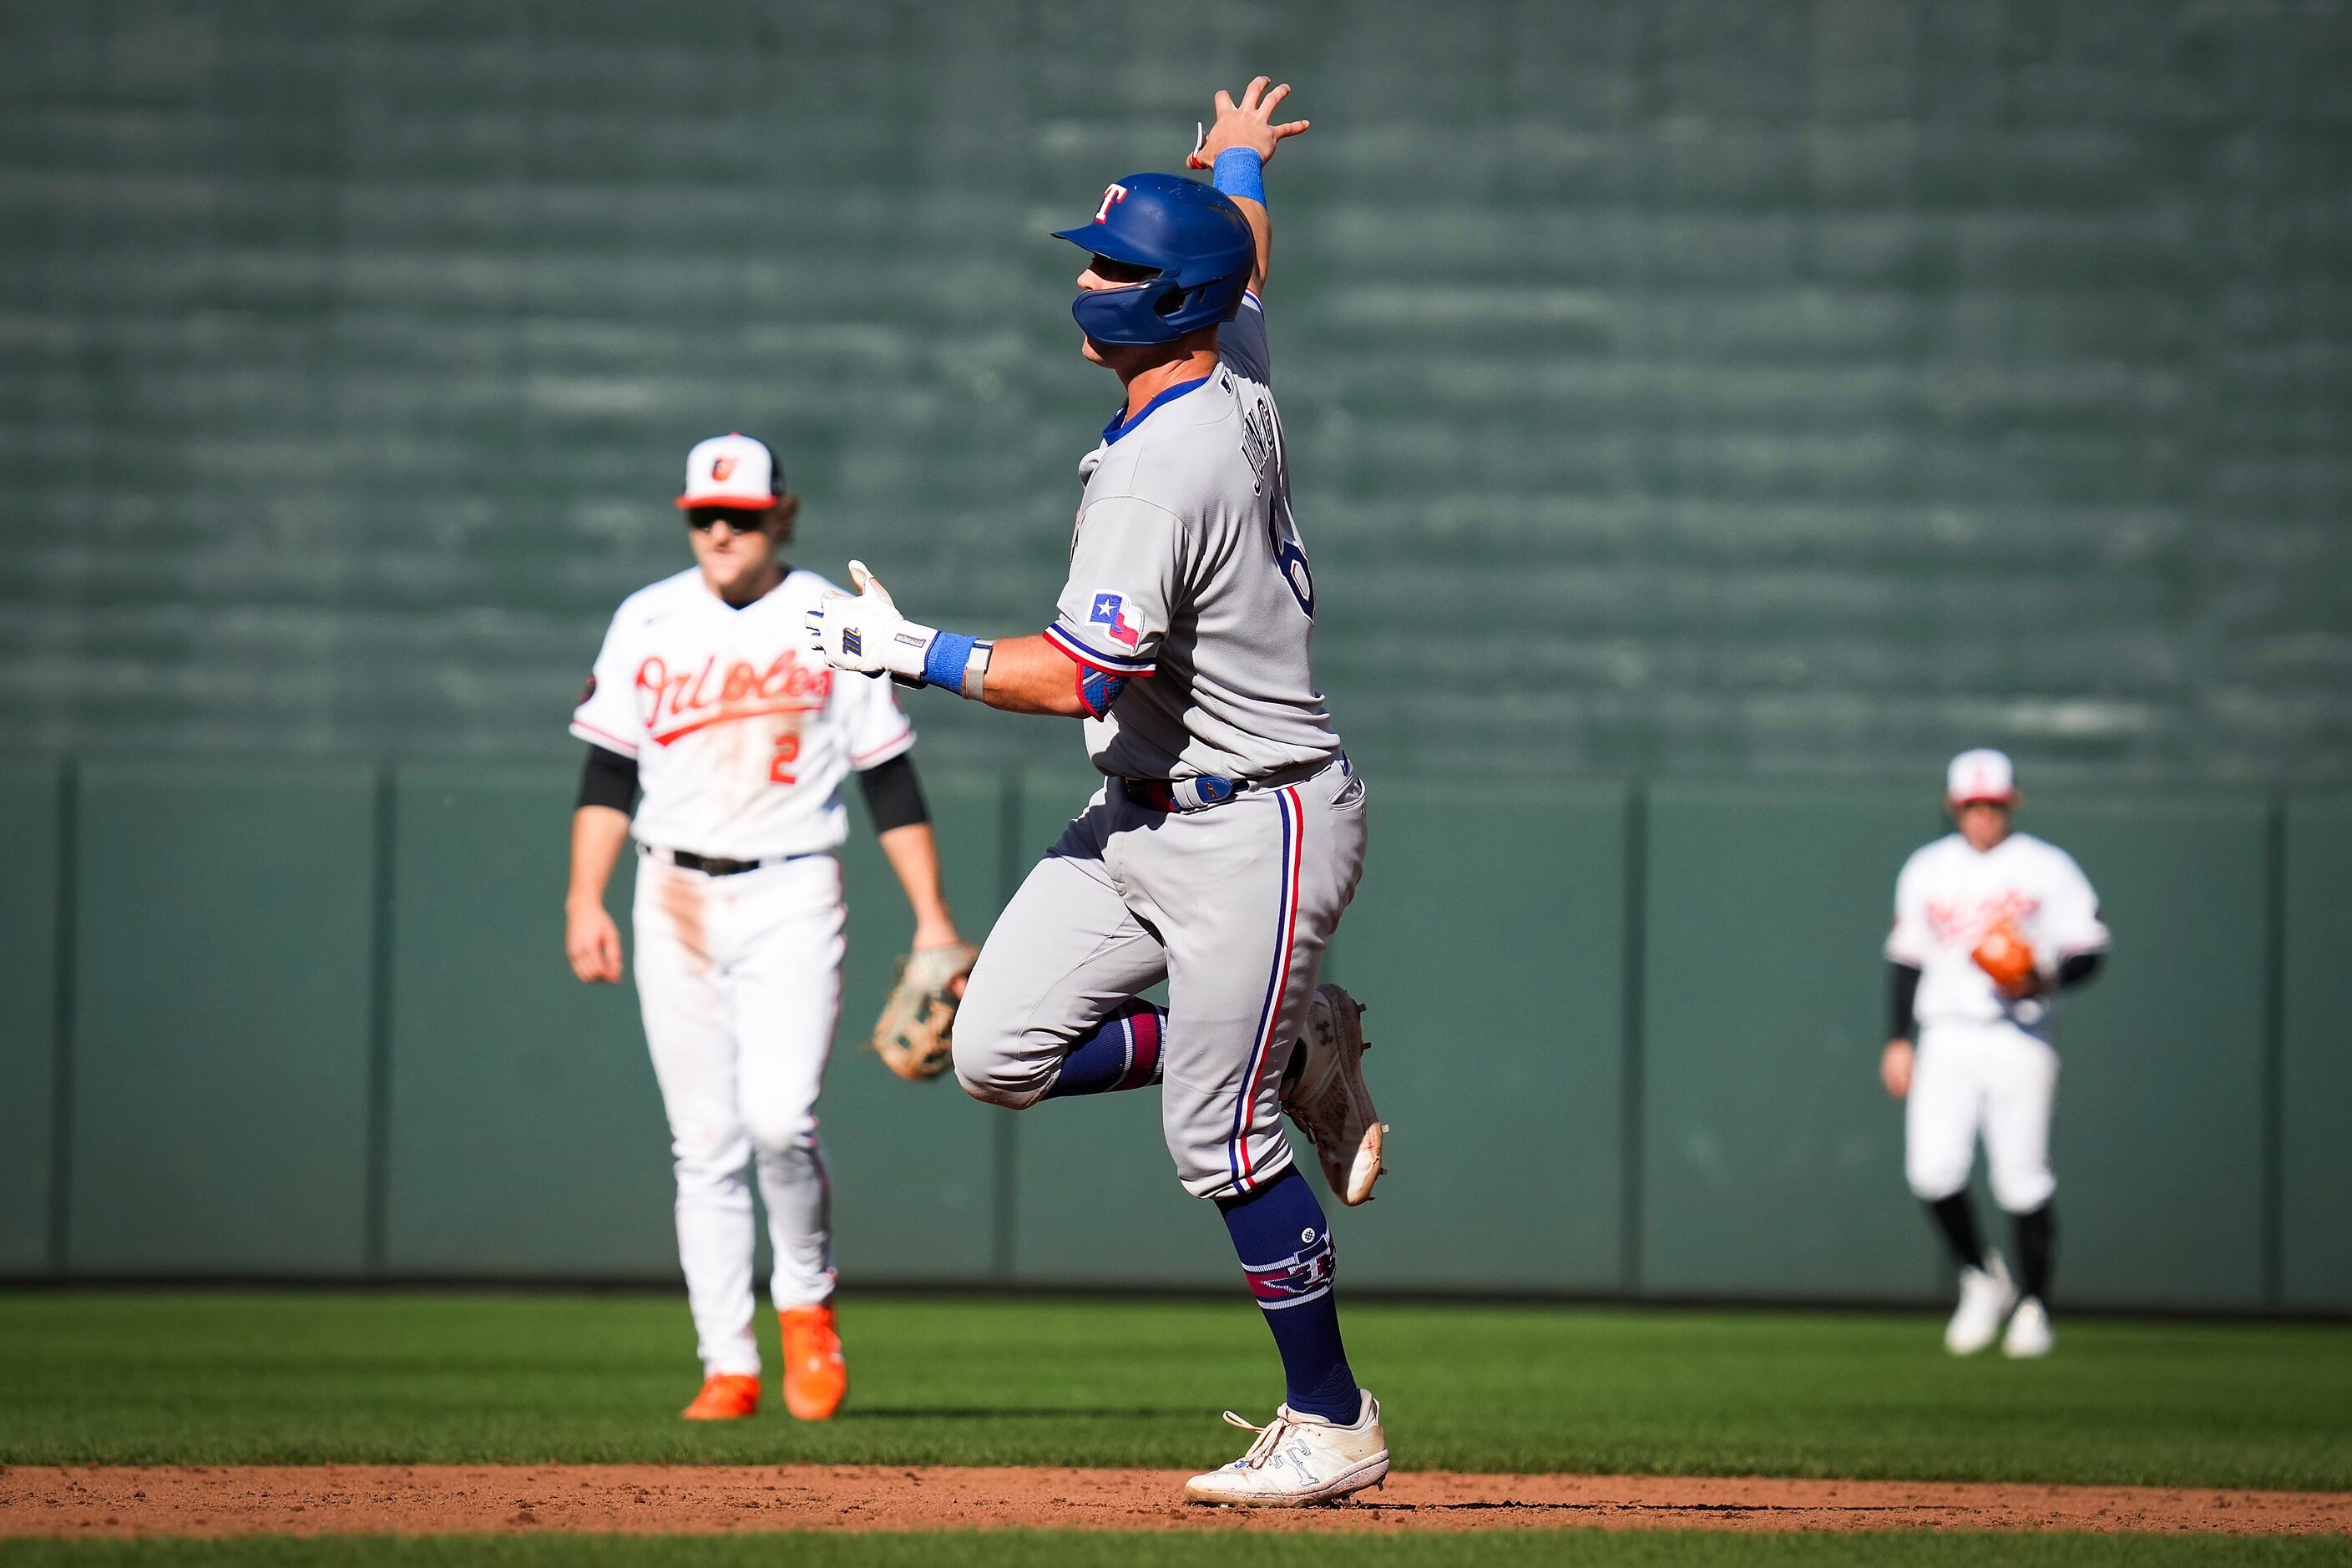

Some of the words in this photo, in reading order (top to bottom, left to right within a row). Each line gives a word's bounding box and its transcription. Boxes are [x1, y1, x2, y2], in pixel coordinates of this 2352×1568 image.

[1094, 183, 1128, 225] T
[635, 649, 832, 729] Orioles
[769, 732, 800, 786] 2
